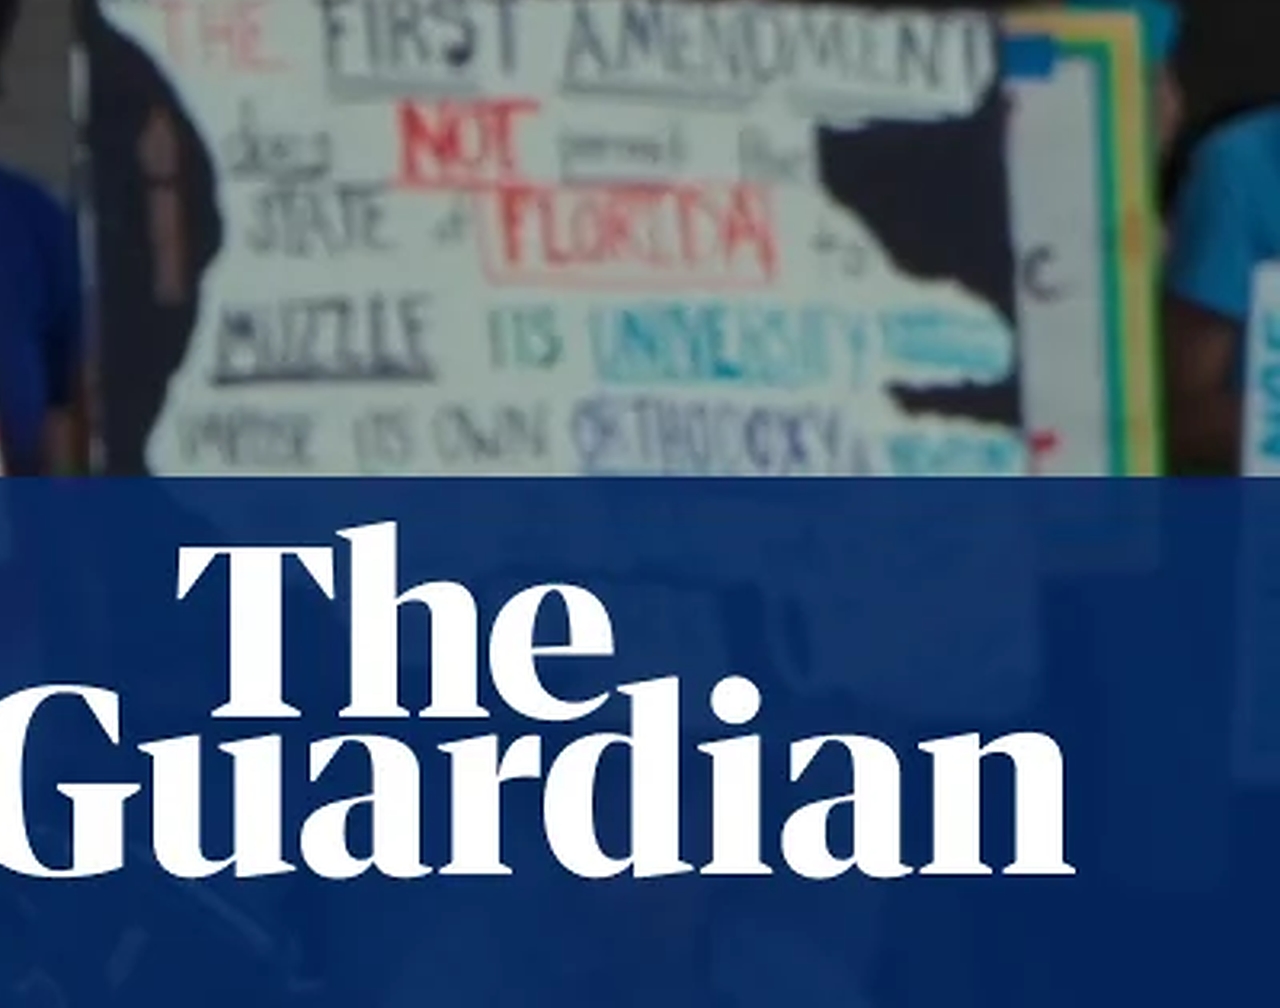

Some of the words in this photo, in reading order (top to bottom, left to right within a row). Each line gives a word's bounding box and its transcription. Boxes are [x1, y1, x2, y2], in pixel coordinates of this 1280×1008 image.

[395, 99, 544, 184] NOT
[243, 184, 396, 257] STATE
[492, 181, 779, 282] FLORIDA
[212, 290, 438, 378] MUZZLE
[484, 303, 564, 371] ITS
